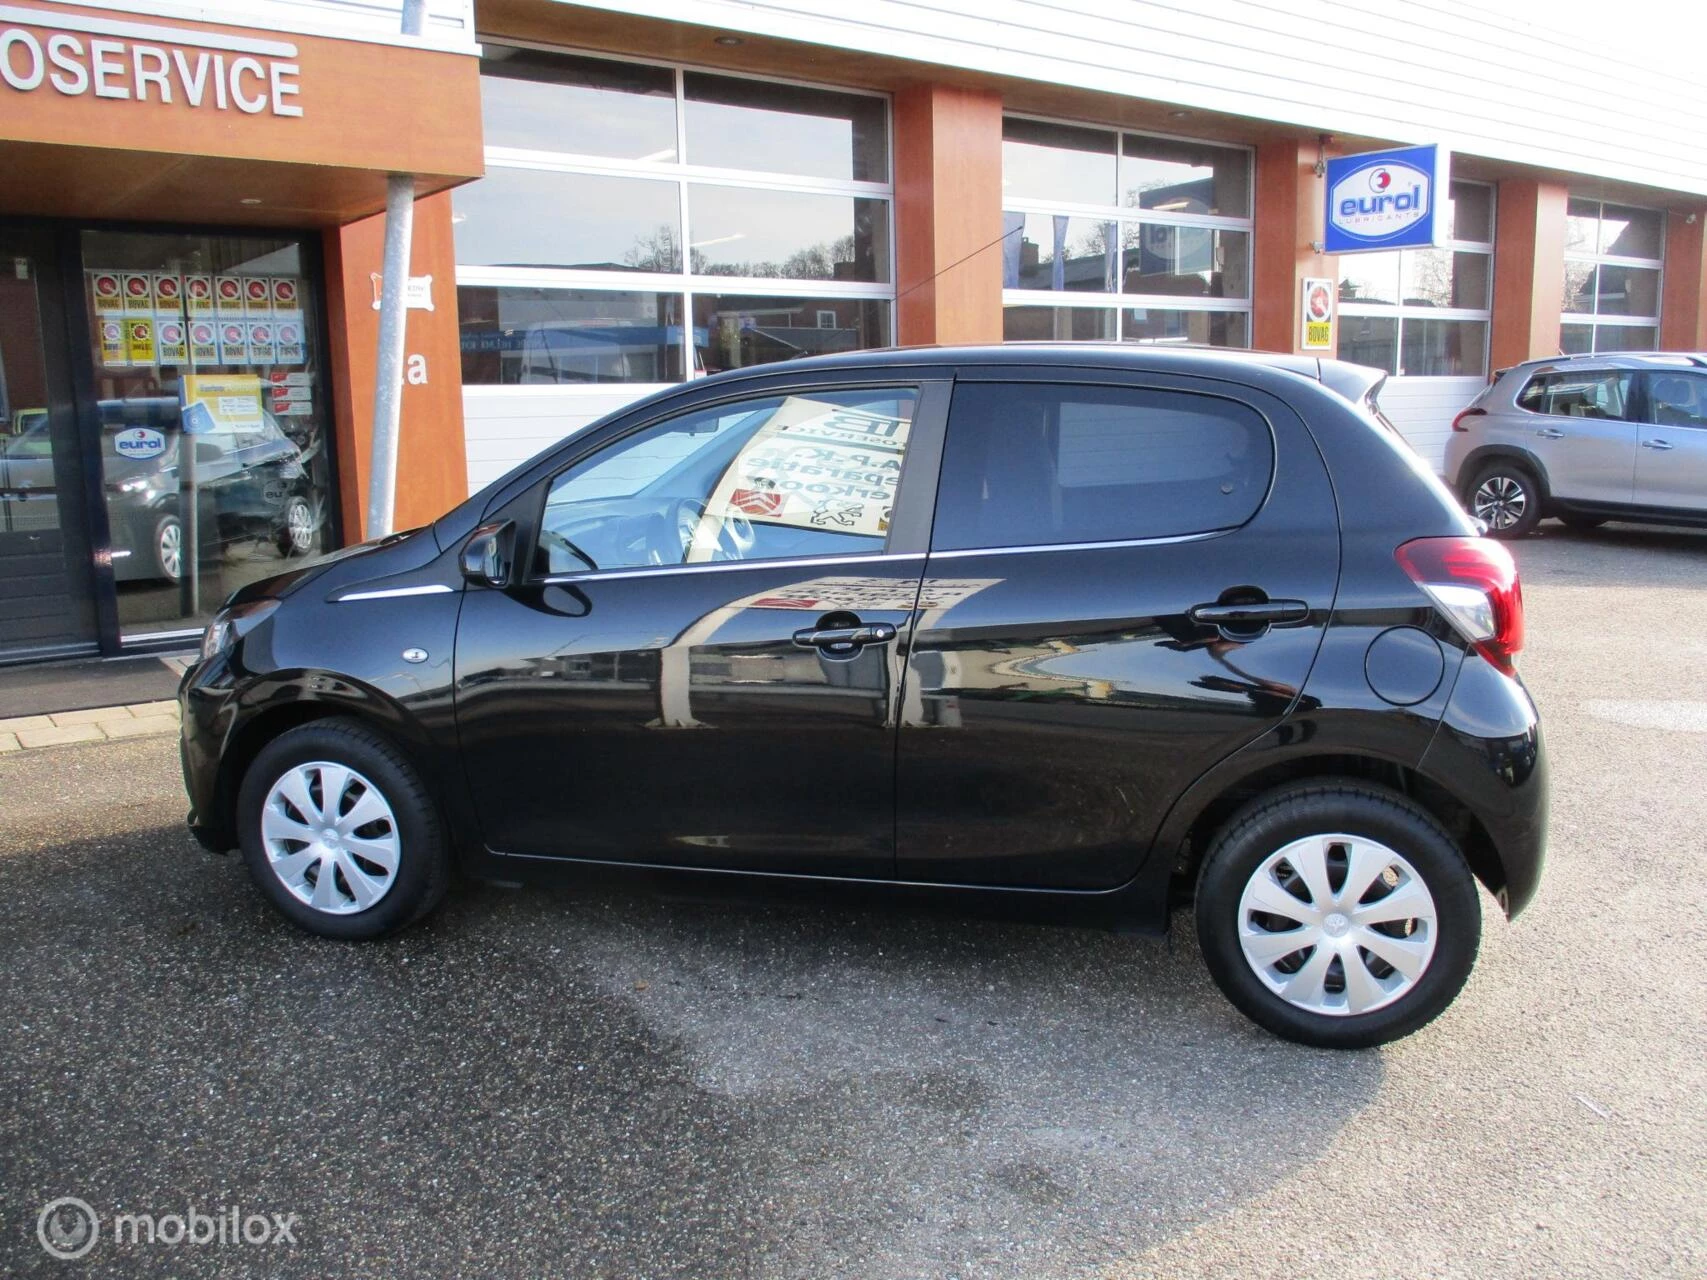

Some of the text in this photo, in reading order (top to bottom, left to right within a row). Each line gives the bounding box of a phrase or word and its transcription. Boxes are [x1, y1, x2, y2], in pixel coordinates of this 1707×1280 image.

[0, 28, 303, 117] OSERVICE
[1340, 184, 1421, 216] eurol
[402, 353, 429, 386] a
[119, 437, 161, 449] eurol
